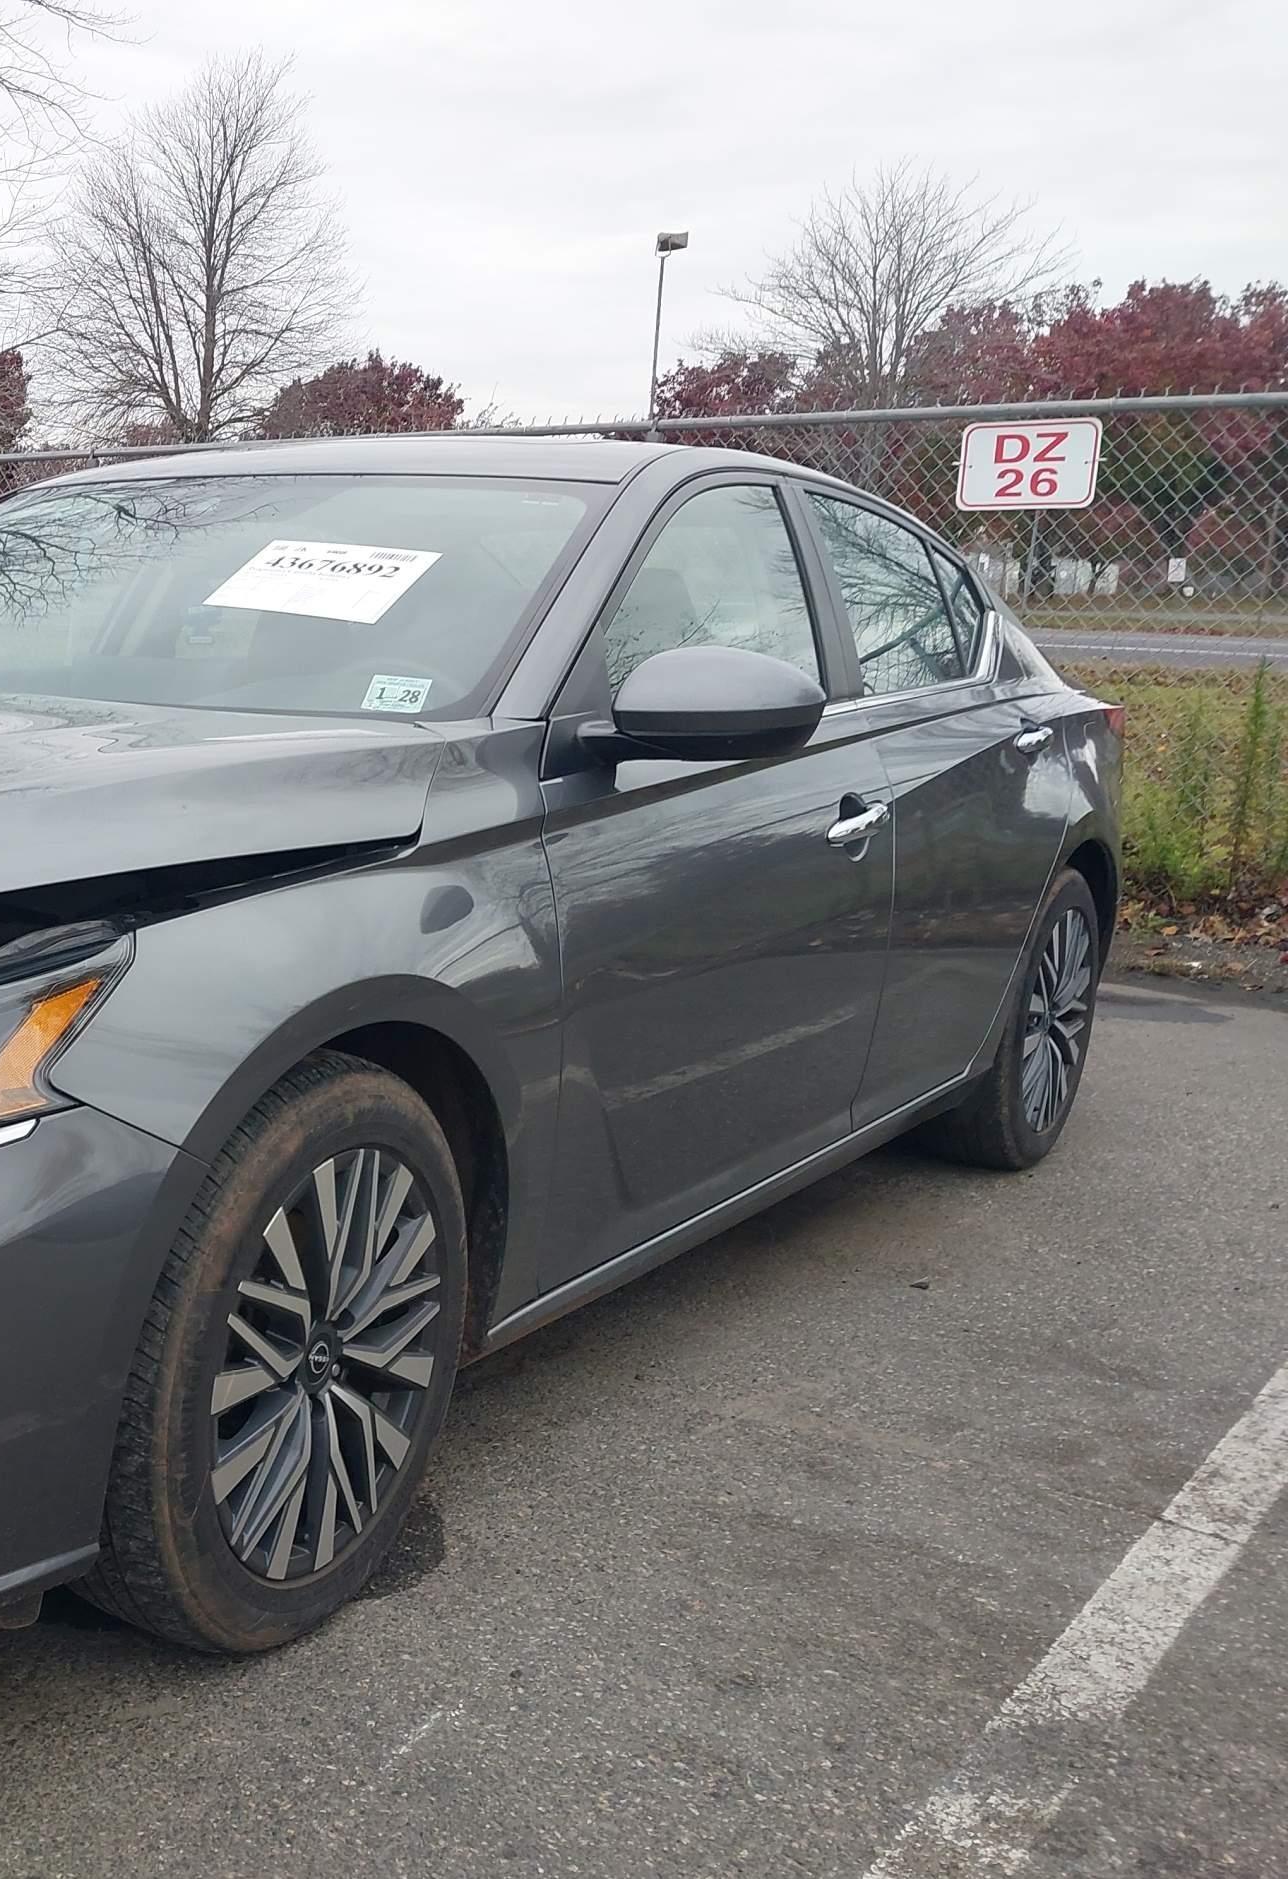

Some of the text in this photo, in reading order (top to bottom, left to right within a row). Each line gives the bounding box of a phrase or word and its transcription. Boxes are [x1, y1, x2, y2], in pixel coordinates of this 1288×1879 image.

[994, 431, 1069, 464] DZ
[994, 468, 1058, 498] 26
[264, 554, 401, 579] 43676892
[375, 687, 422, 704] 1 28
